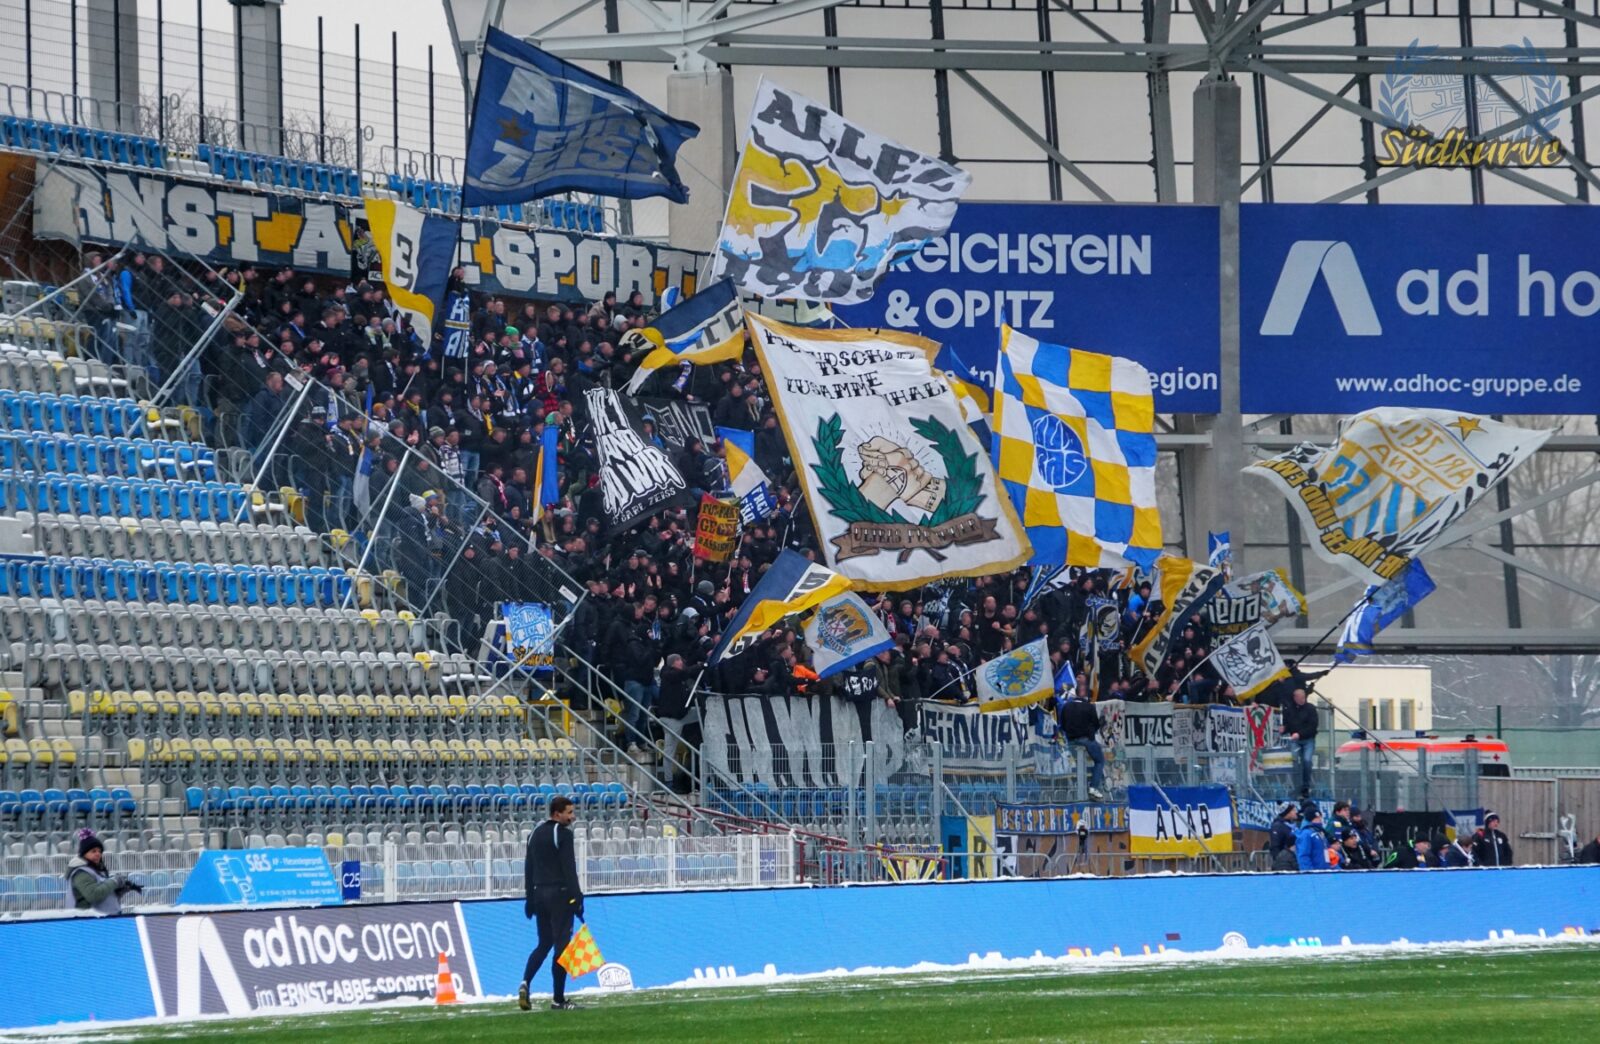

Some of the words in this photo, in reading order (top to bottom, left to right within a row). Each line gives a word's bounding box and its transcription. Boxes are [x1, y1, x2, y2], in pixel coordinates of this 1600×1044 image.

[757, 89, 956, 193] ALLEZ
[1396, 253, 1490, 317] ad
[885, 289, 920, 328] &
[926, 289, 1055, 329] OPITZ
[1148, 366, 1218, 396] egion
[1336, 373, 1582, 398] www.adhoc-gruppe.de
[1155, 802, 1214, 844] ACAB
[342, 875, 361, 889] C25
[243, 915, 292, 969] ad
[289, 914, 359, 966] hoc
[361, 919, 457, 963] arena
[254, 985, 276, 1009] im
[277, 973, 464, 1007] ERNST-ABBE-SPORTFD
